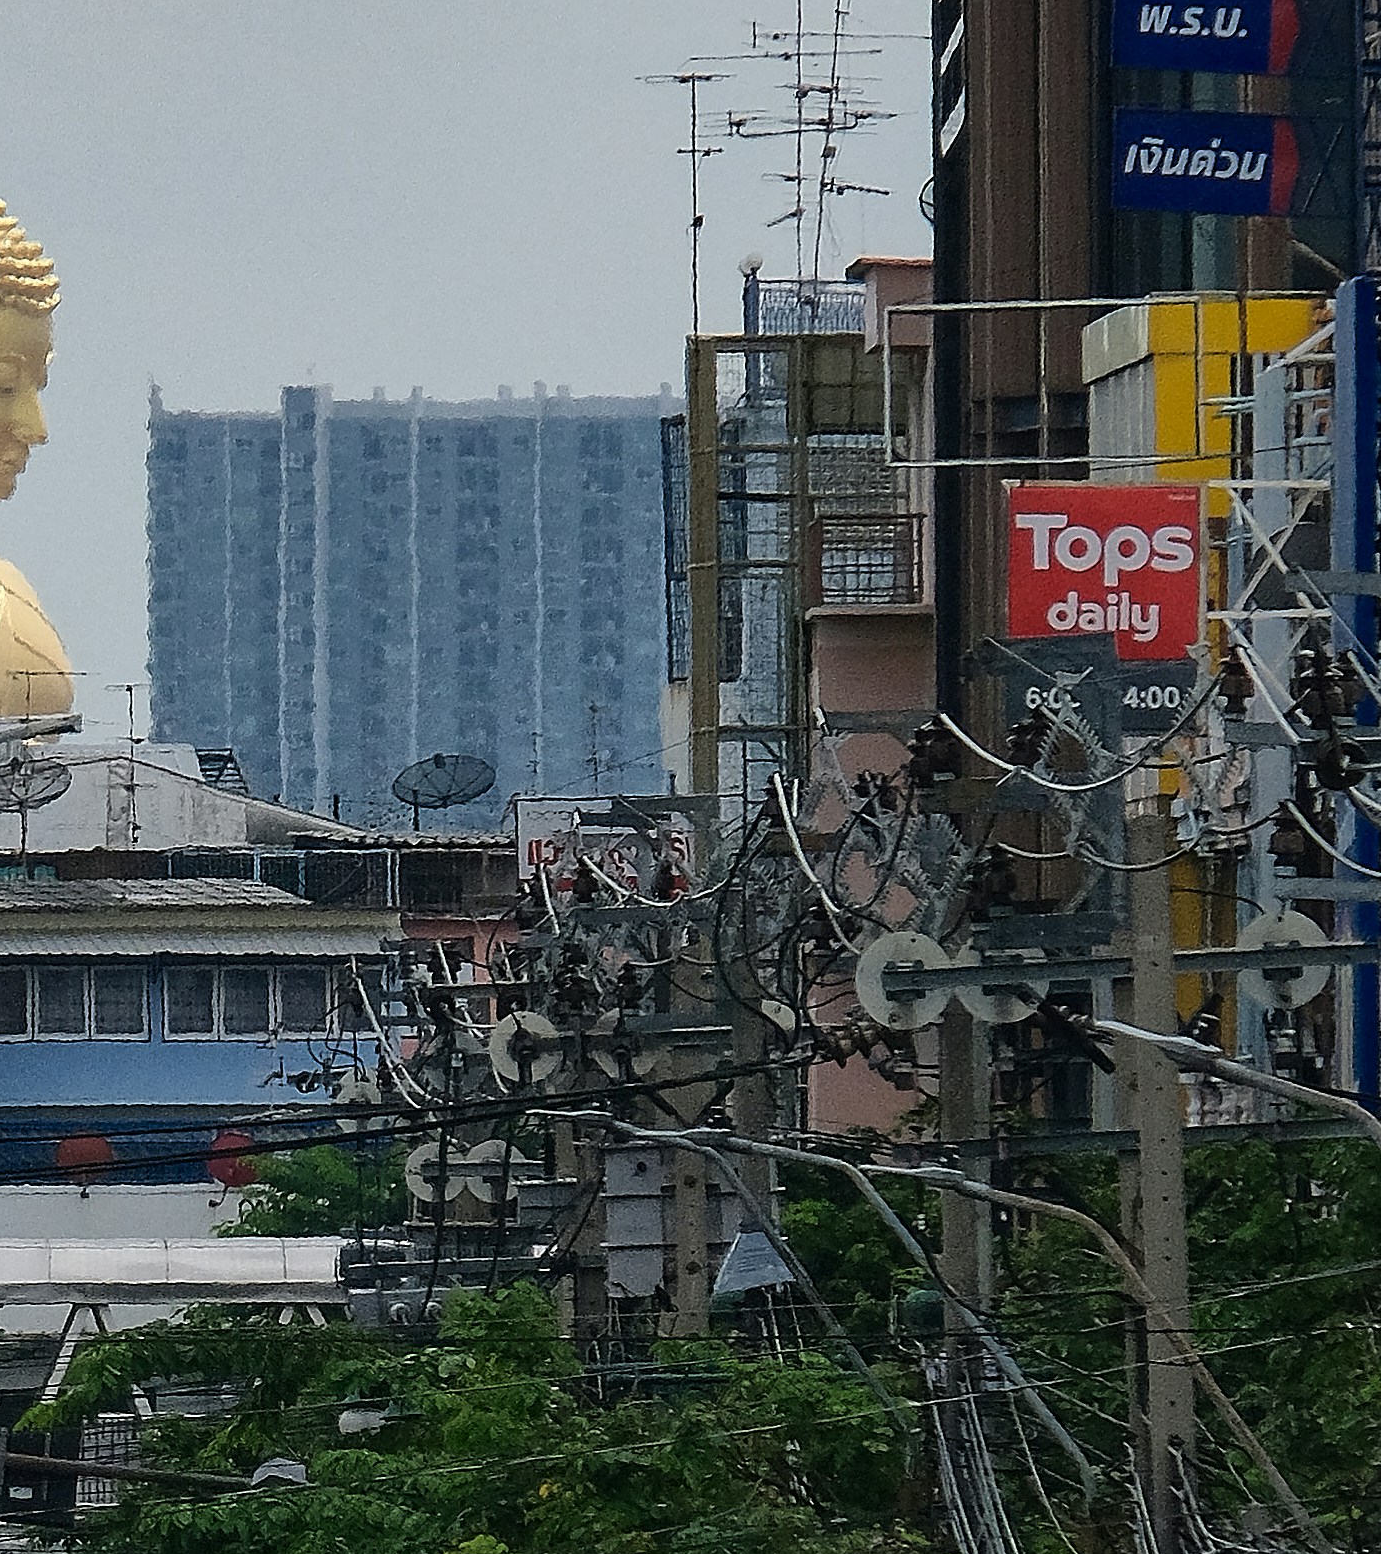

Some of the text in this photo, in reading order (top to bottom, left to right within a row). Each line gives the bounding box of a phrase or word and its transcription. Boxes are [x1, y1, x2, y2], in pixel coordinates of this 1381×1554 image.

[1138, 4, 1248, 38] พ.ร.บ.
[1123, 137, 1268, 182] เงินด่วน
[1015, 513, 1195, 587] Tops
[1046, 591, 1161, 643] daily
